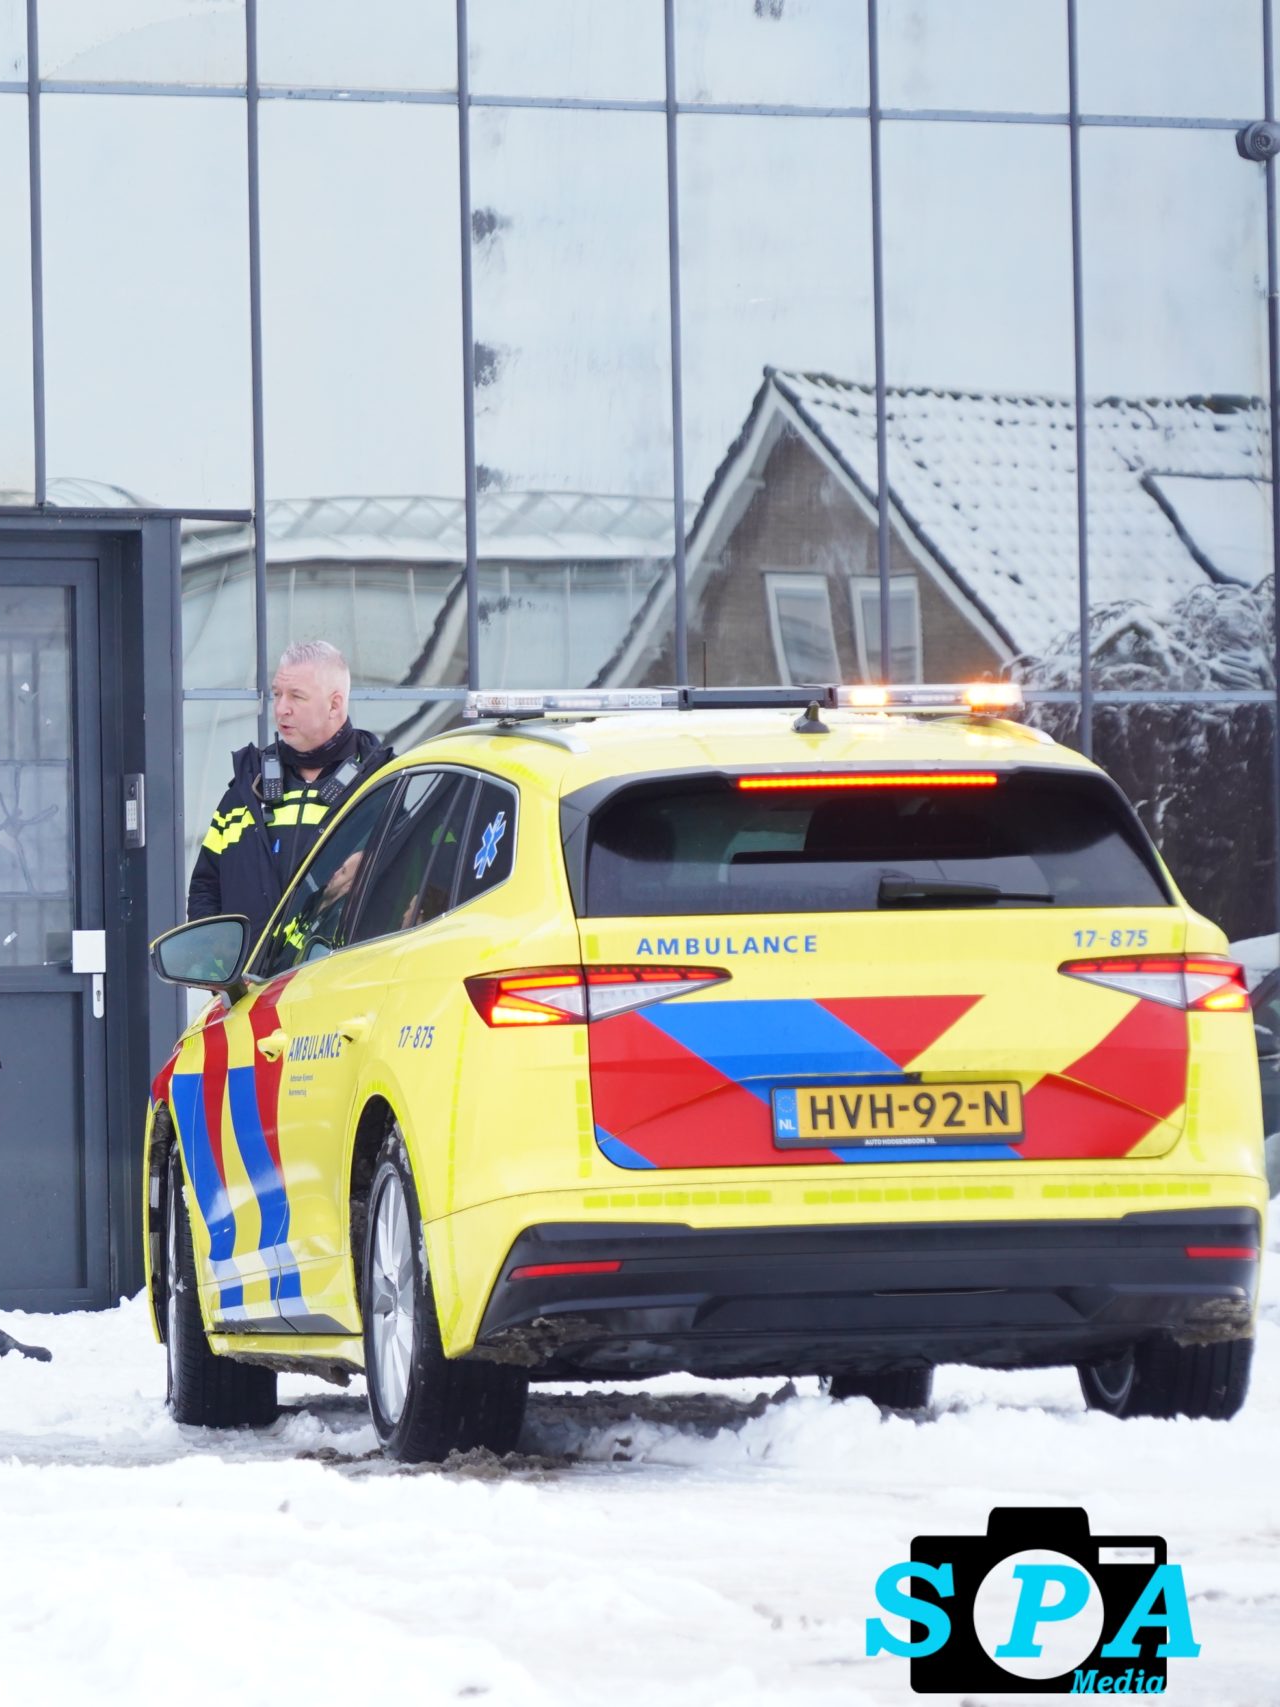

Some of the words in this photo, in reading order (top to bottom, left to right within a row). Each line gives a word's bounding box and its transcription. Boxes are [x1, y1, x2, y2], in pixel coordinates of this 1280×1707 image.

[636, 935, 817, 956] AMBULANCE
[1073, 929, 1149, 948] 17-875
[287, 1032, 342, 1062] AMBULANCE
[398, 1026, 435, 1048] 17-875
[810, 1091, 1010, 1130] HVH-92-N
[779, 1119, 796, 1130] NL
